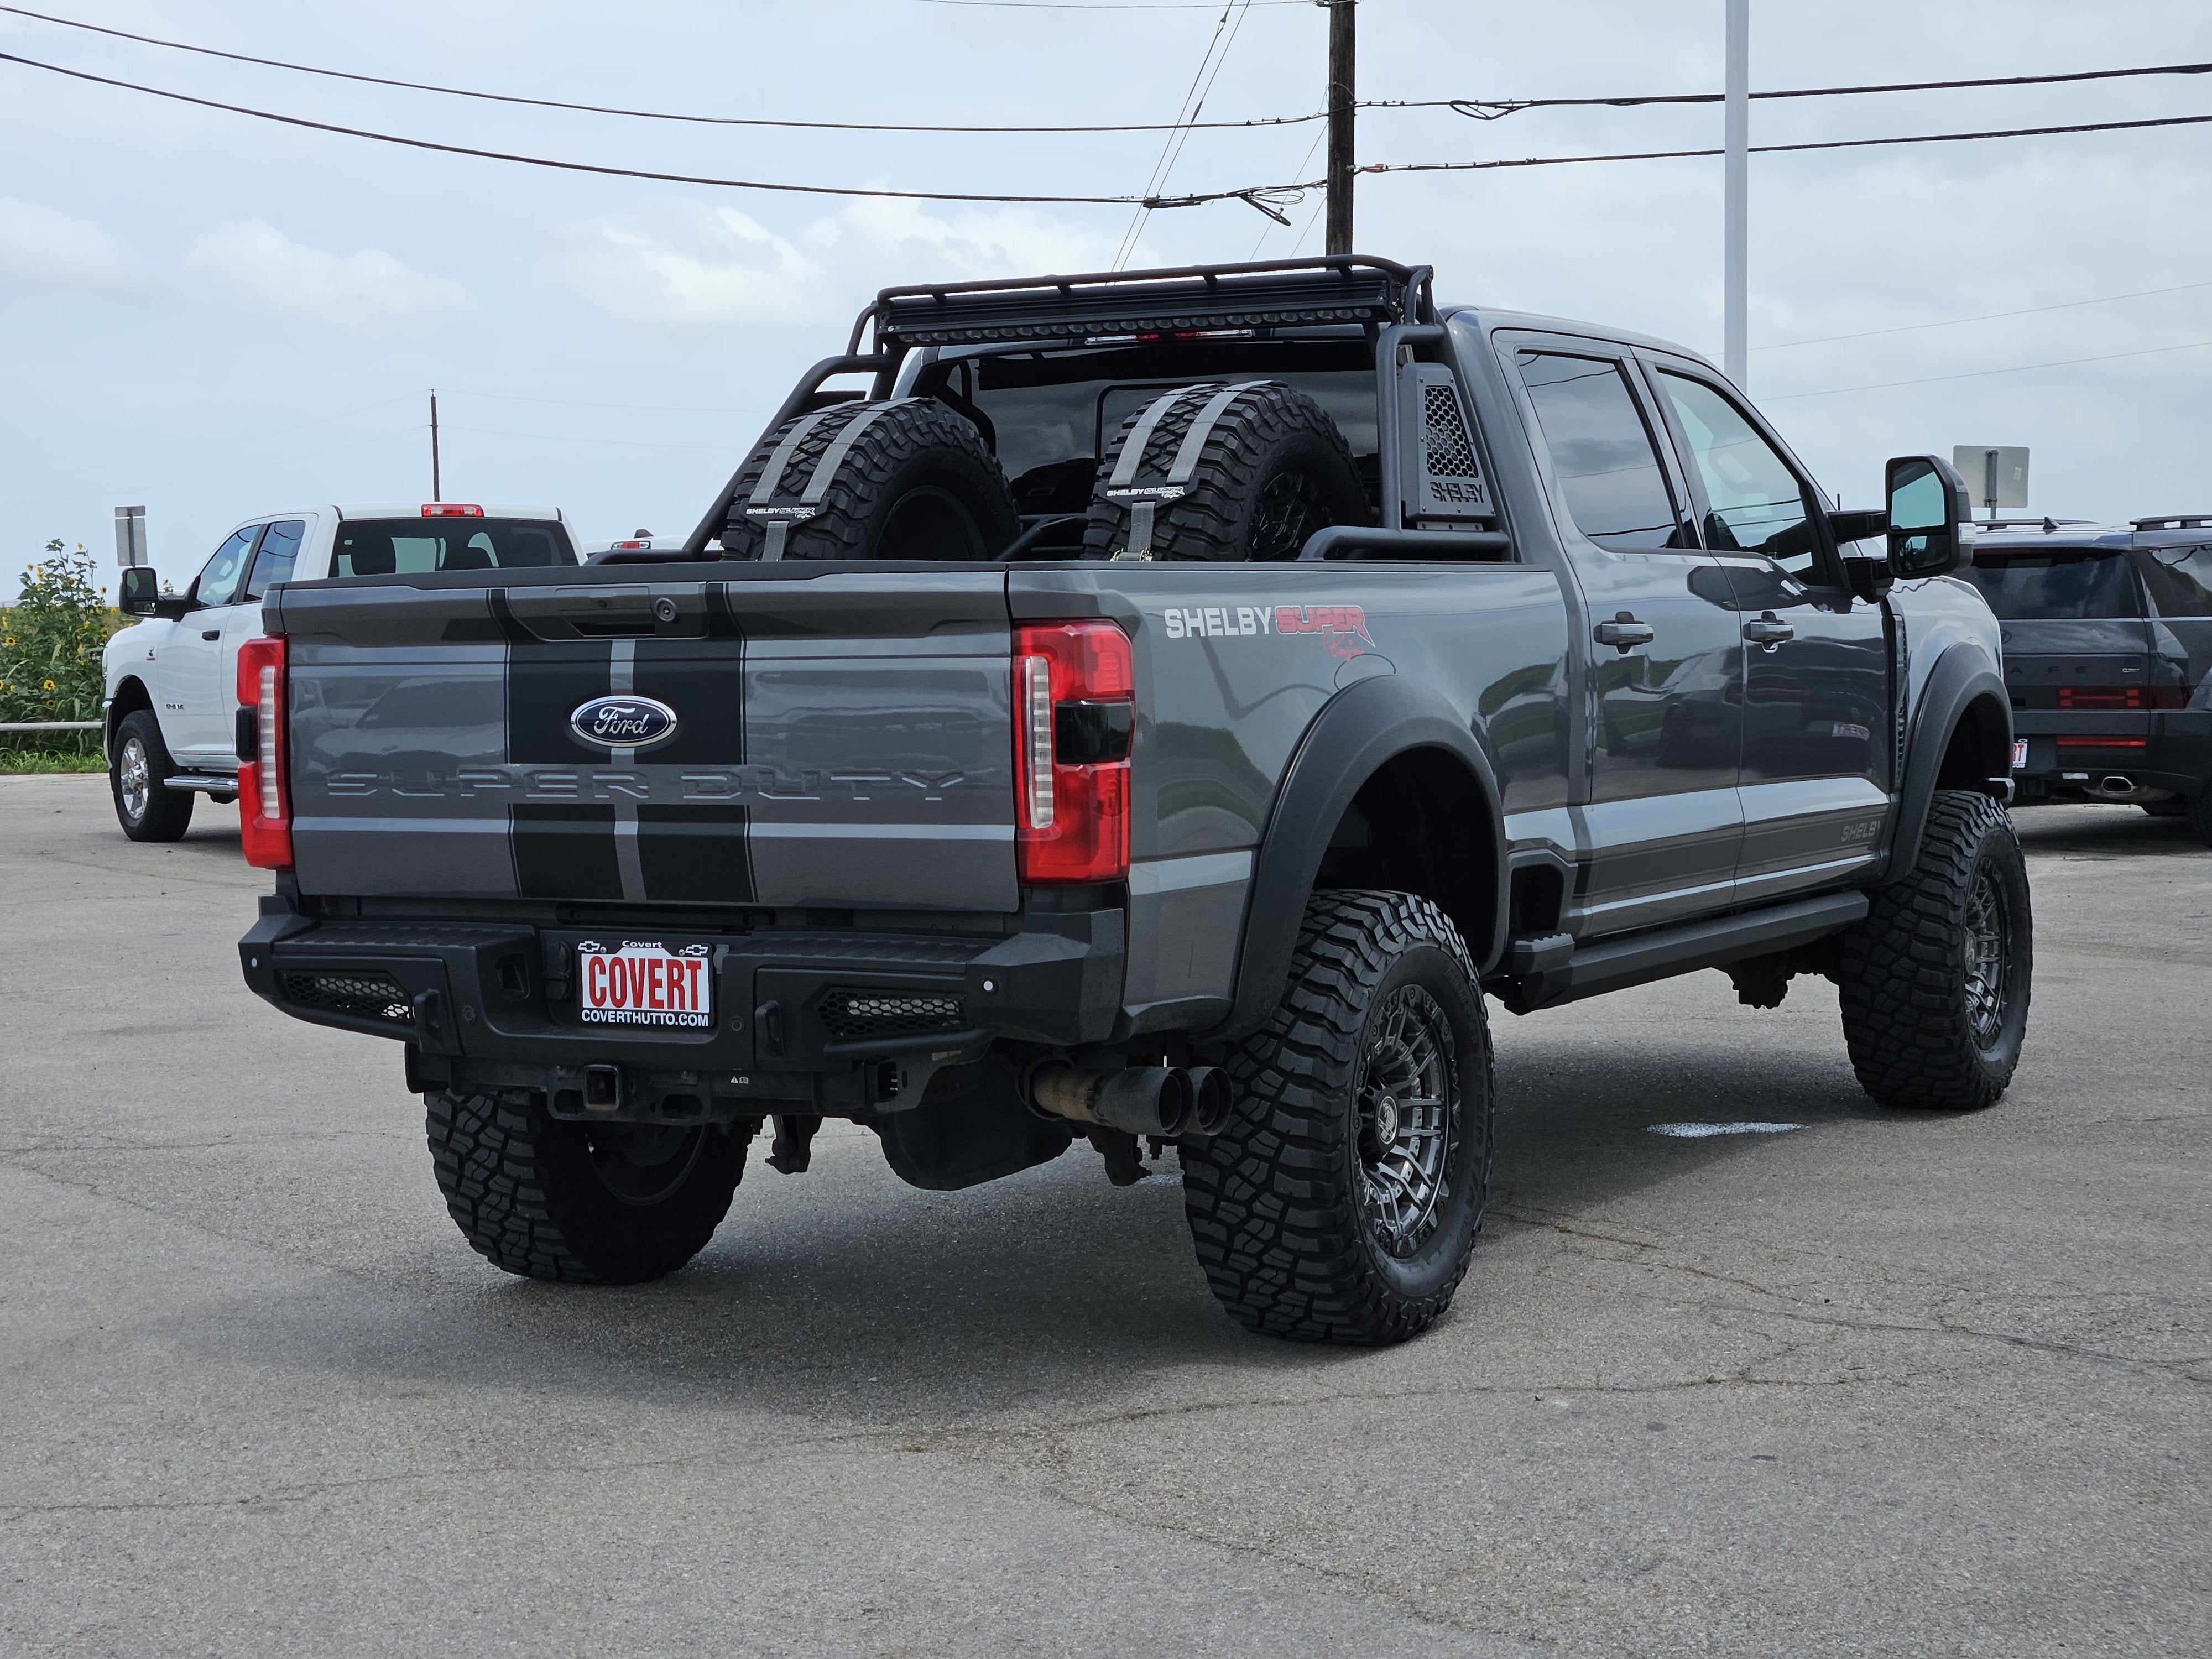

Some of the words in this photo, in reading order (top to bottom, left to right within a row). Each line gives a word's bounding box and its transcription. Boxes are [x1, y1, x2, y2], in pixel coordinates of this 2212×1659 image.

[1107, 488, 1144, 497] SHELBY
[1430, 482, 1484, 504] SHELBY
[1164, 607, 1271, 638] SHELBY
[1274, 605, 1375, 647] SUPER
[2010, 666, 2088, 674] AFE
[593, 706, 650, 734] Ford
[327, 769, 649, 799] SUPER
[681, 770, 964, 801] DUTY
[622, 940, 663, 949] Covert
[588, 956, 702, 1011] COVERT
[581, 1010, 709, 1027] COVERTHUTTO.COM
